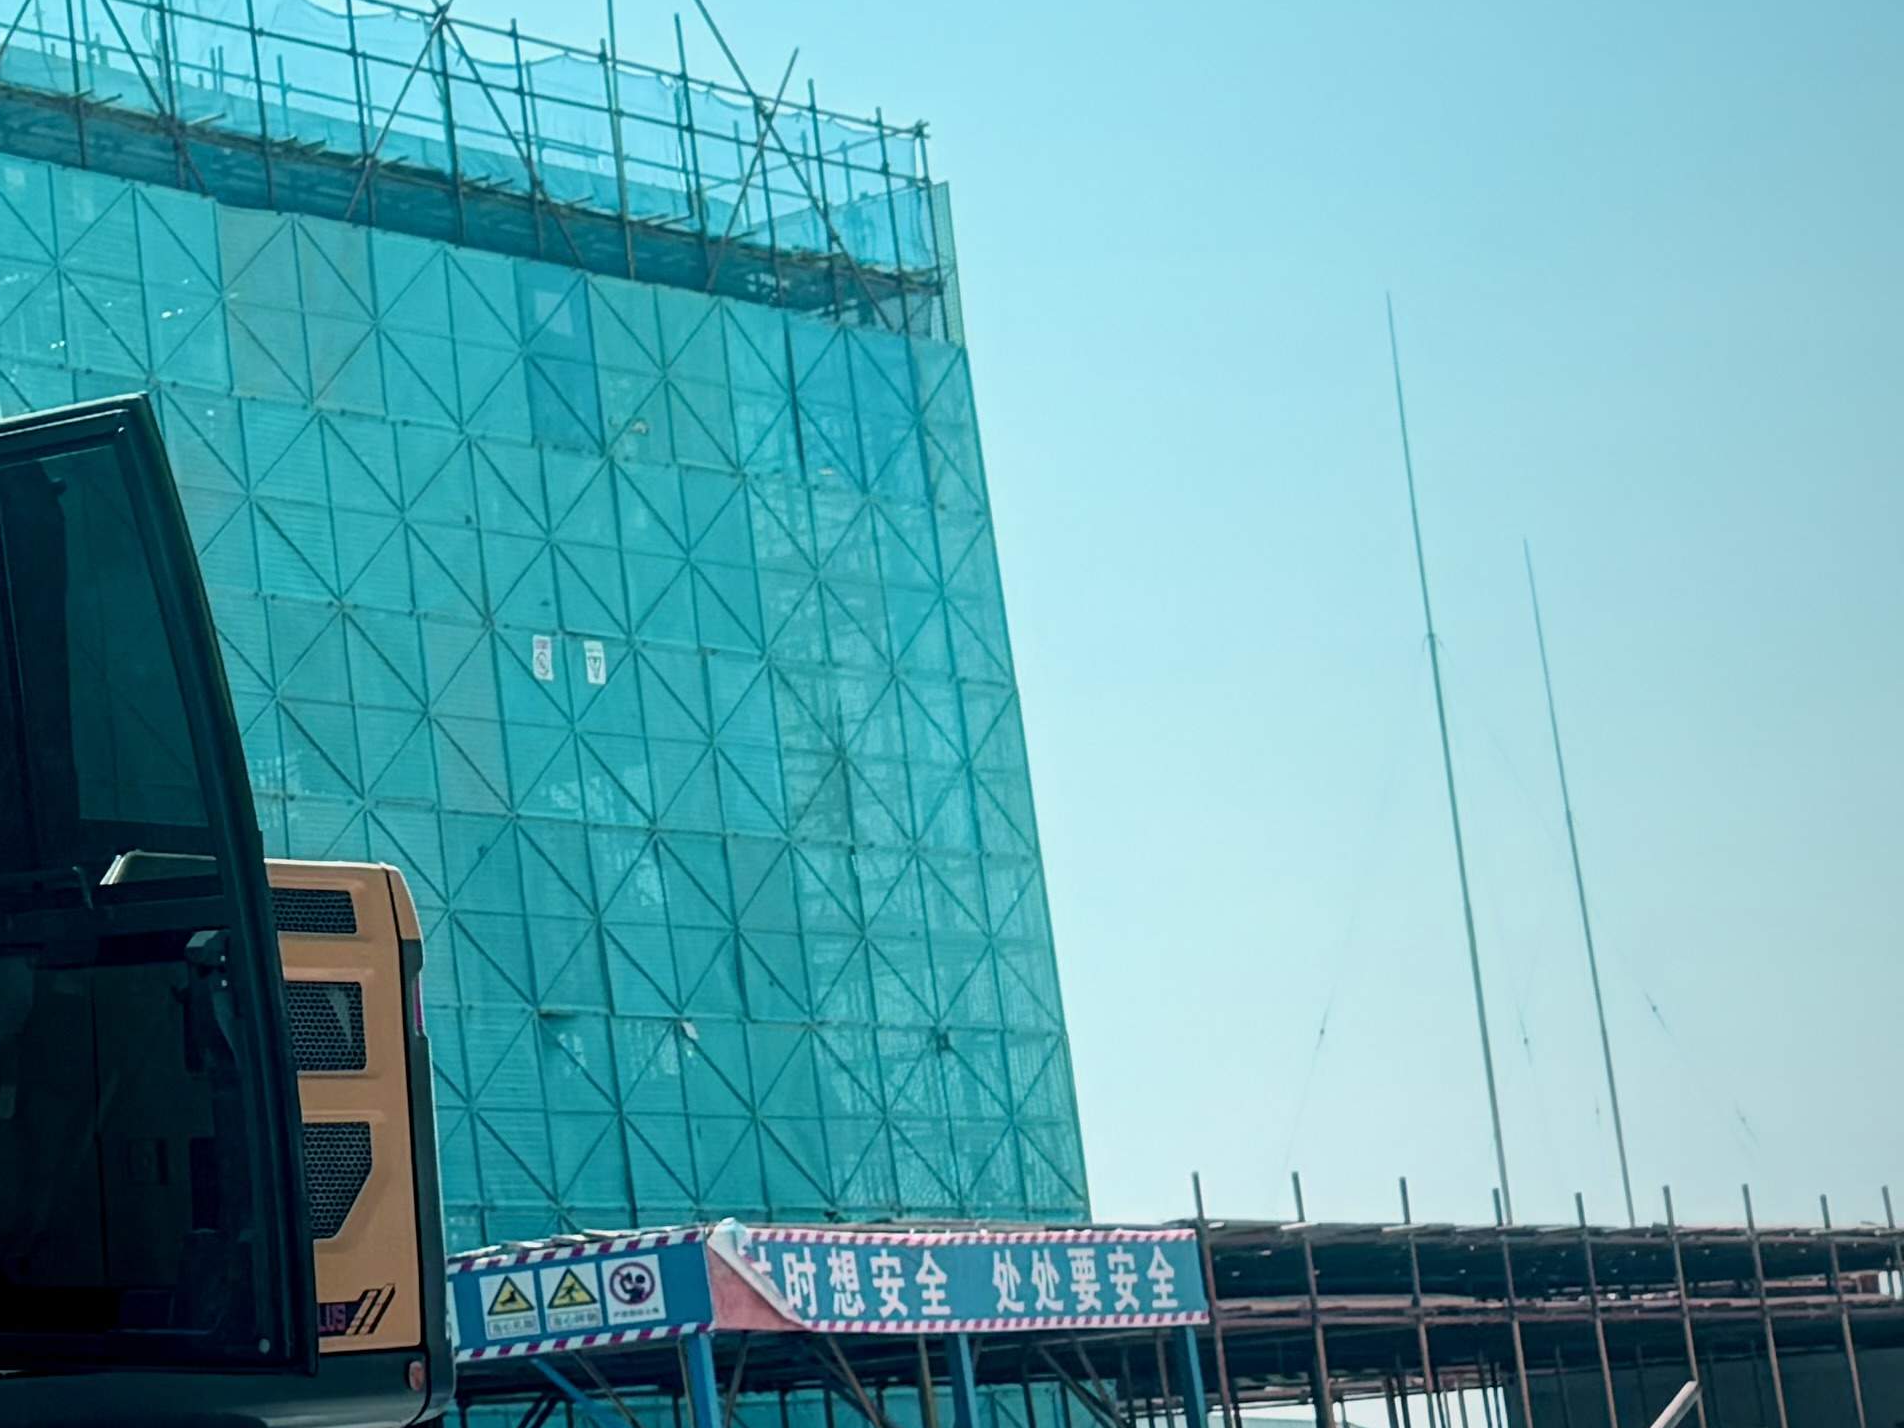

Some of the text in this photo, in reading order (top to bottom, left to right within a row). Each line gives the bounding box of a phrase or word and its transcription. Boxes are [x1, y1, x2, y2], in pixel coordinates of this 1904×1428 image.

[993, 1245, 1179, 1314] 处处要安全
